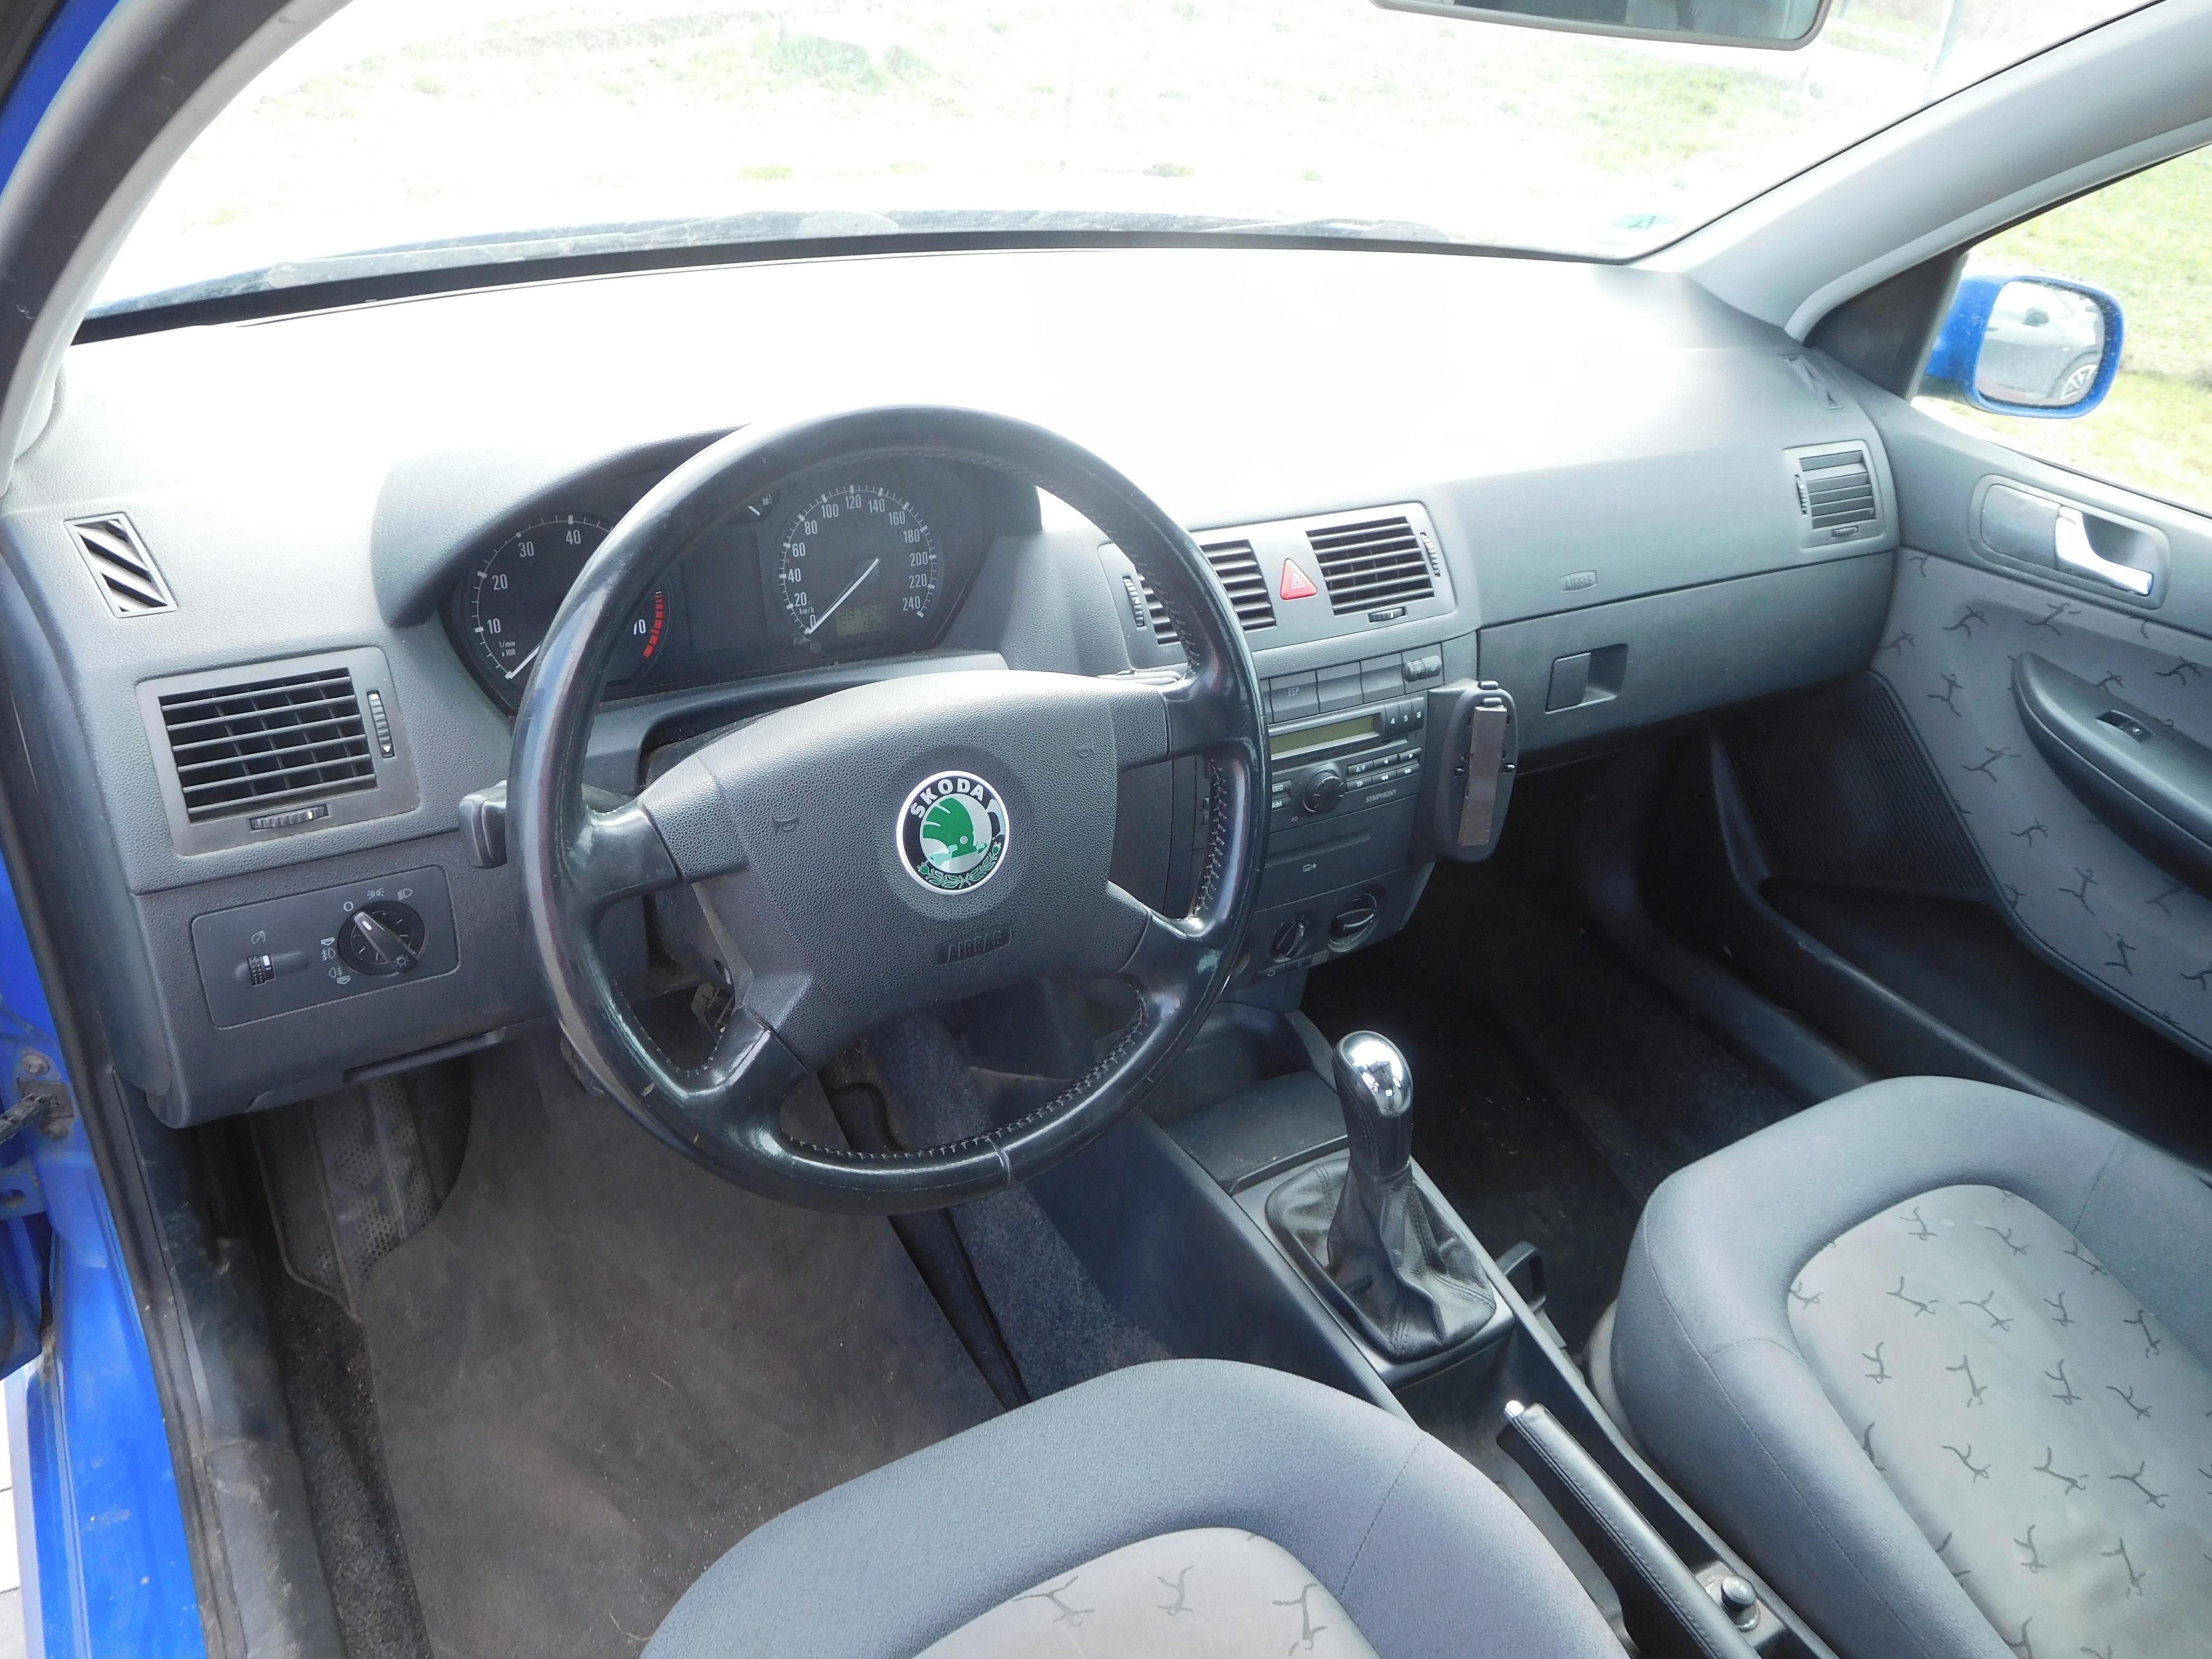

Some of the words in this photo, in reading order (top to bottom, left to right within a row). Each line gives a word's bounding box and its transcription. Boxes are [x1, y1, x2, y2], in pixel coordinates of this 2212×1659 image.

[845, 495, 861, 510] 120
[868, 499, 885, 514] 140
[821, 504, 839, 518] 100
[888, 511, 906, 525] 160
[805, 521, 818, 535] 80
[903, 528, 920, 543] 180
[566, 530, 581, 545] 40
[518, 542, 535, 557] 30
[792, 543, 806, 557] 60
[910, 551, 928, 567] 200
[492, 574, 508, 590] 20
[787, 568, 801, 582] 40
[909, 574, 927, 589] 220
[794, 592, 807, 607] 20
[902, 596, 921, 611] 240
[799, 606, 814, 615] km/h
[487, 618, 501, 634] 10
[810, 615, 816, 626] 0
[1288, 686, 1300, 697] ESP
[1355, 765, 1366, 773] A/F
[1365, 789, 1398, 803] SYMPHONY
[947, 930, 1002, 962] AIRBAG
